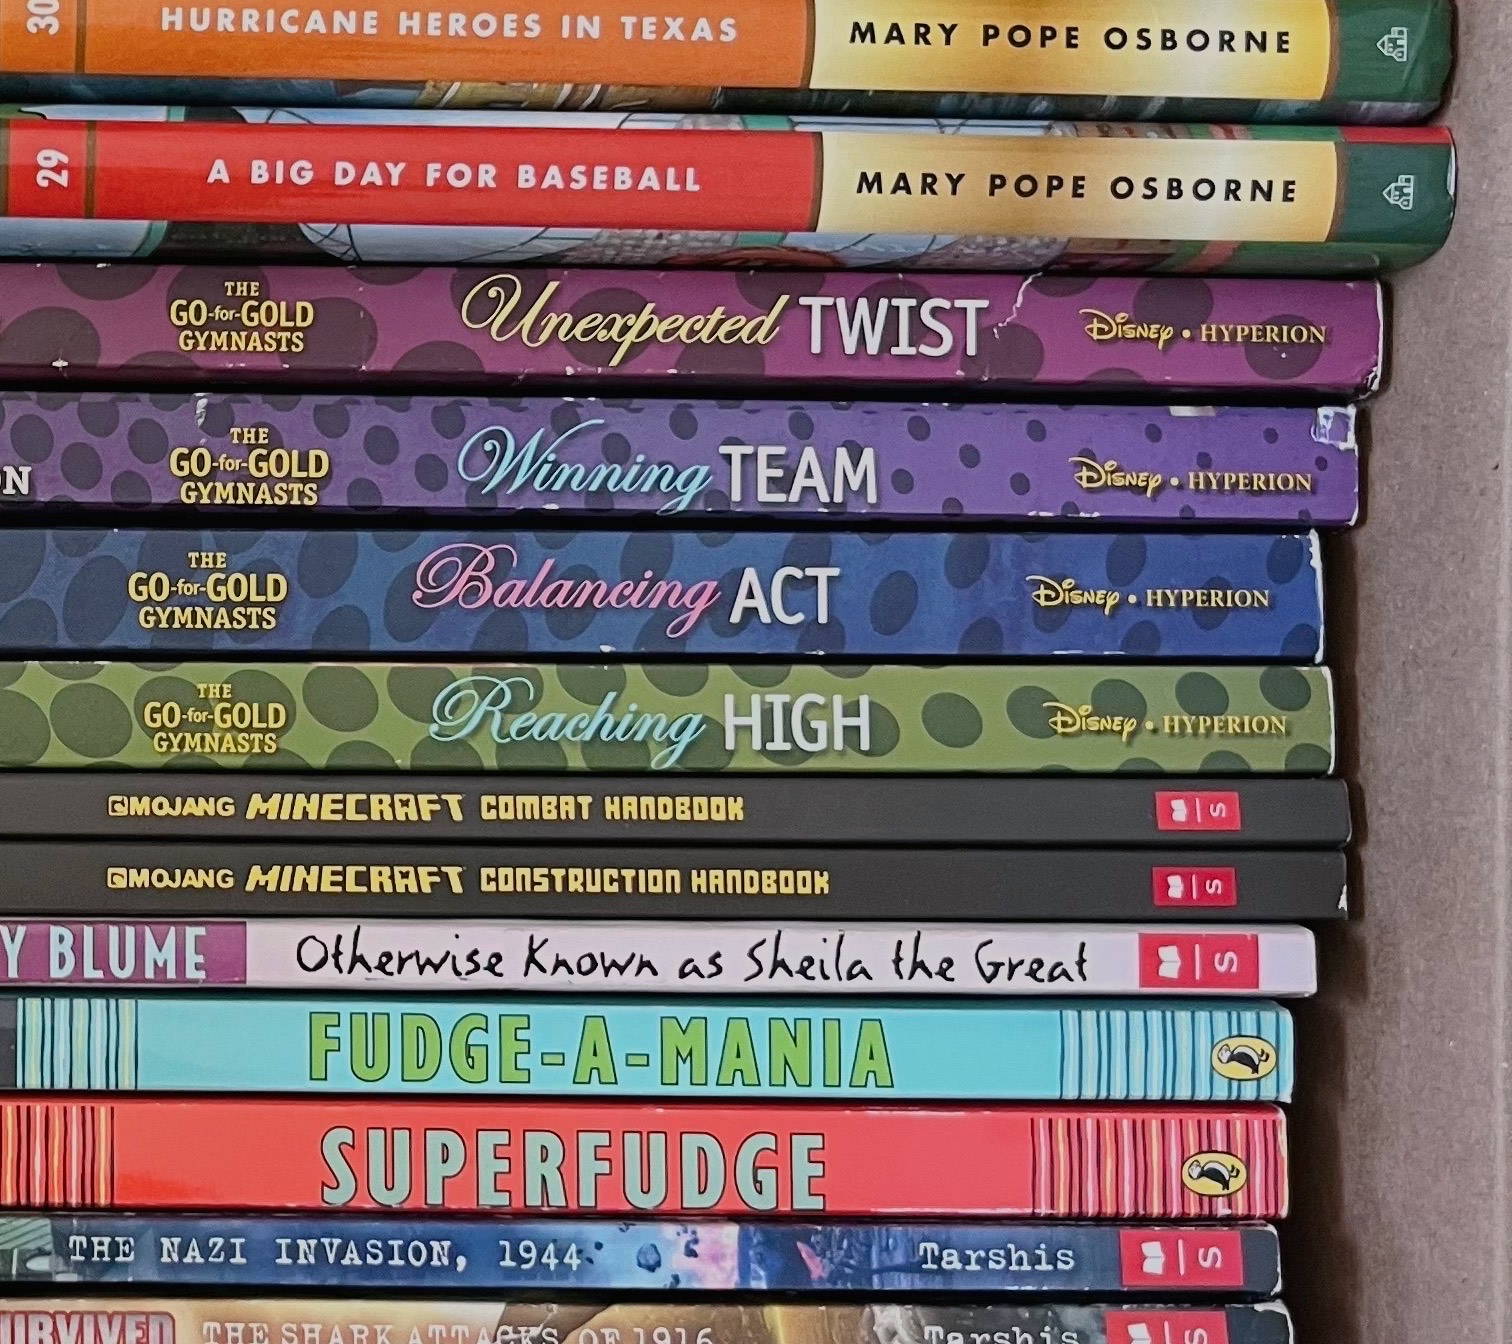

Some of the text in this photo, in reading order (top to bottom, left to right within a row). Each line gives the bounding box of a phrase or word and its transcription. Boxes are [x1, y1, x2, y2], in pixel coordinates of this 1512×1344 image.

[161, 7, 737, 41] HURRICANE HEROES IN TEXAS
[849, 22, 1291, 54] MARY POPE OSBORNE
[225, 281, 260, 297] THE
[463, 274, 990, 365] Unexpected TWIST
[1200, 324, 1327, 344] HYPERION
[180, 330, 303, 352] GYMNASTS
[129, 793, 744, 822] MOJANG MINECRAFT COMBAT HANDBOOK
[50, 926, 206, 980] BLUME
[296, 926, 1088, 984] Otherwise Known as Sheila the Great
[310, 1011, 894, 1089] FUDGE-A-MANIA
[321, 1126, 826, 1212] SUPERFUDGE
